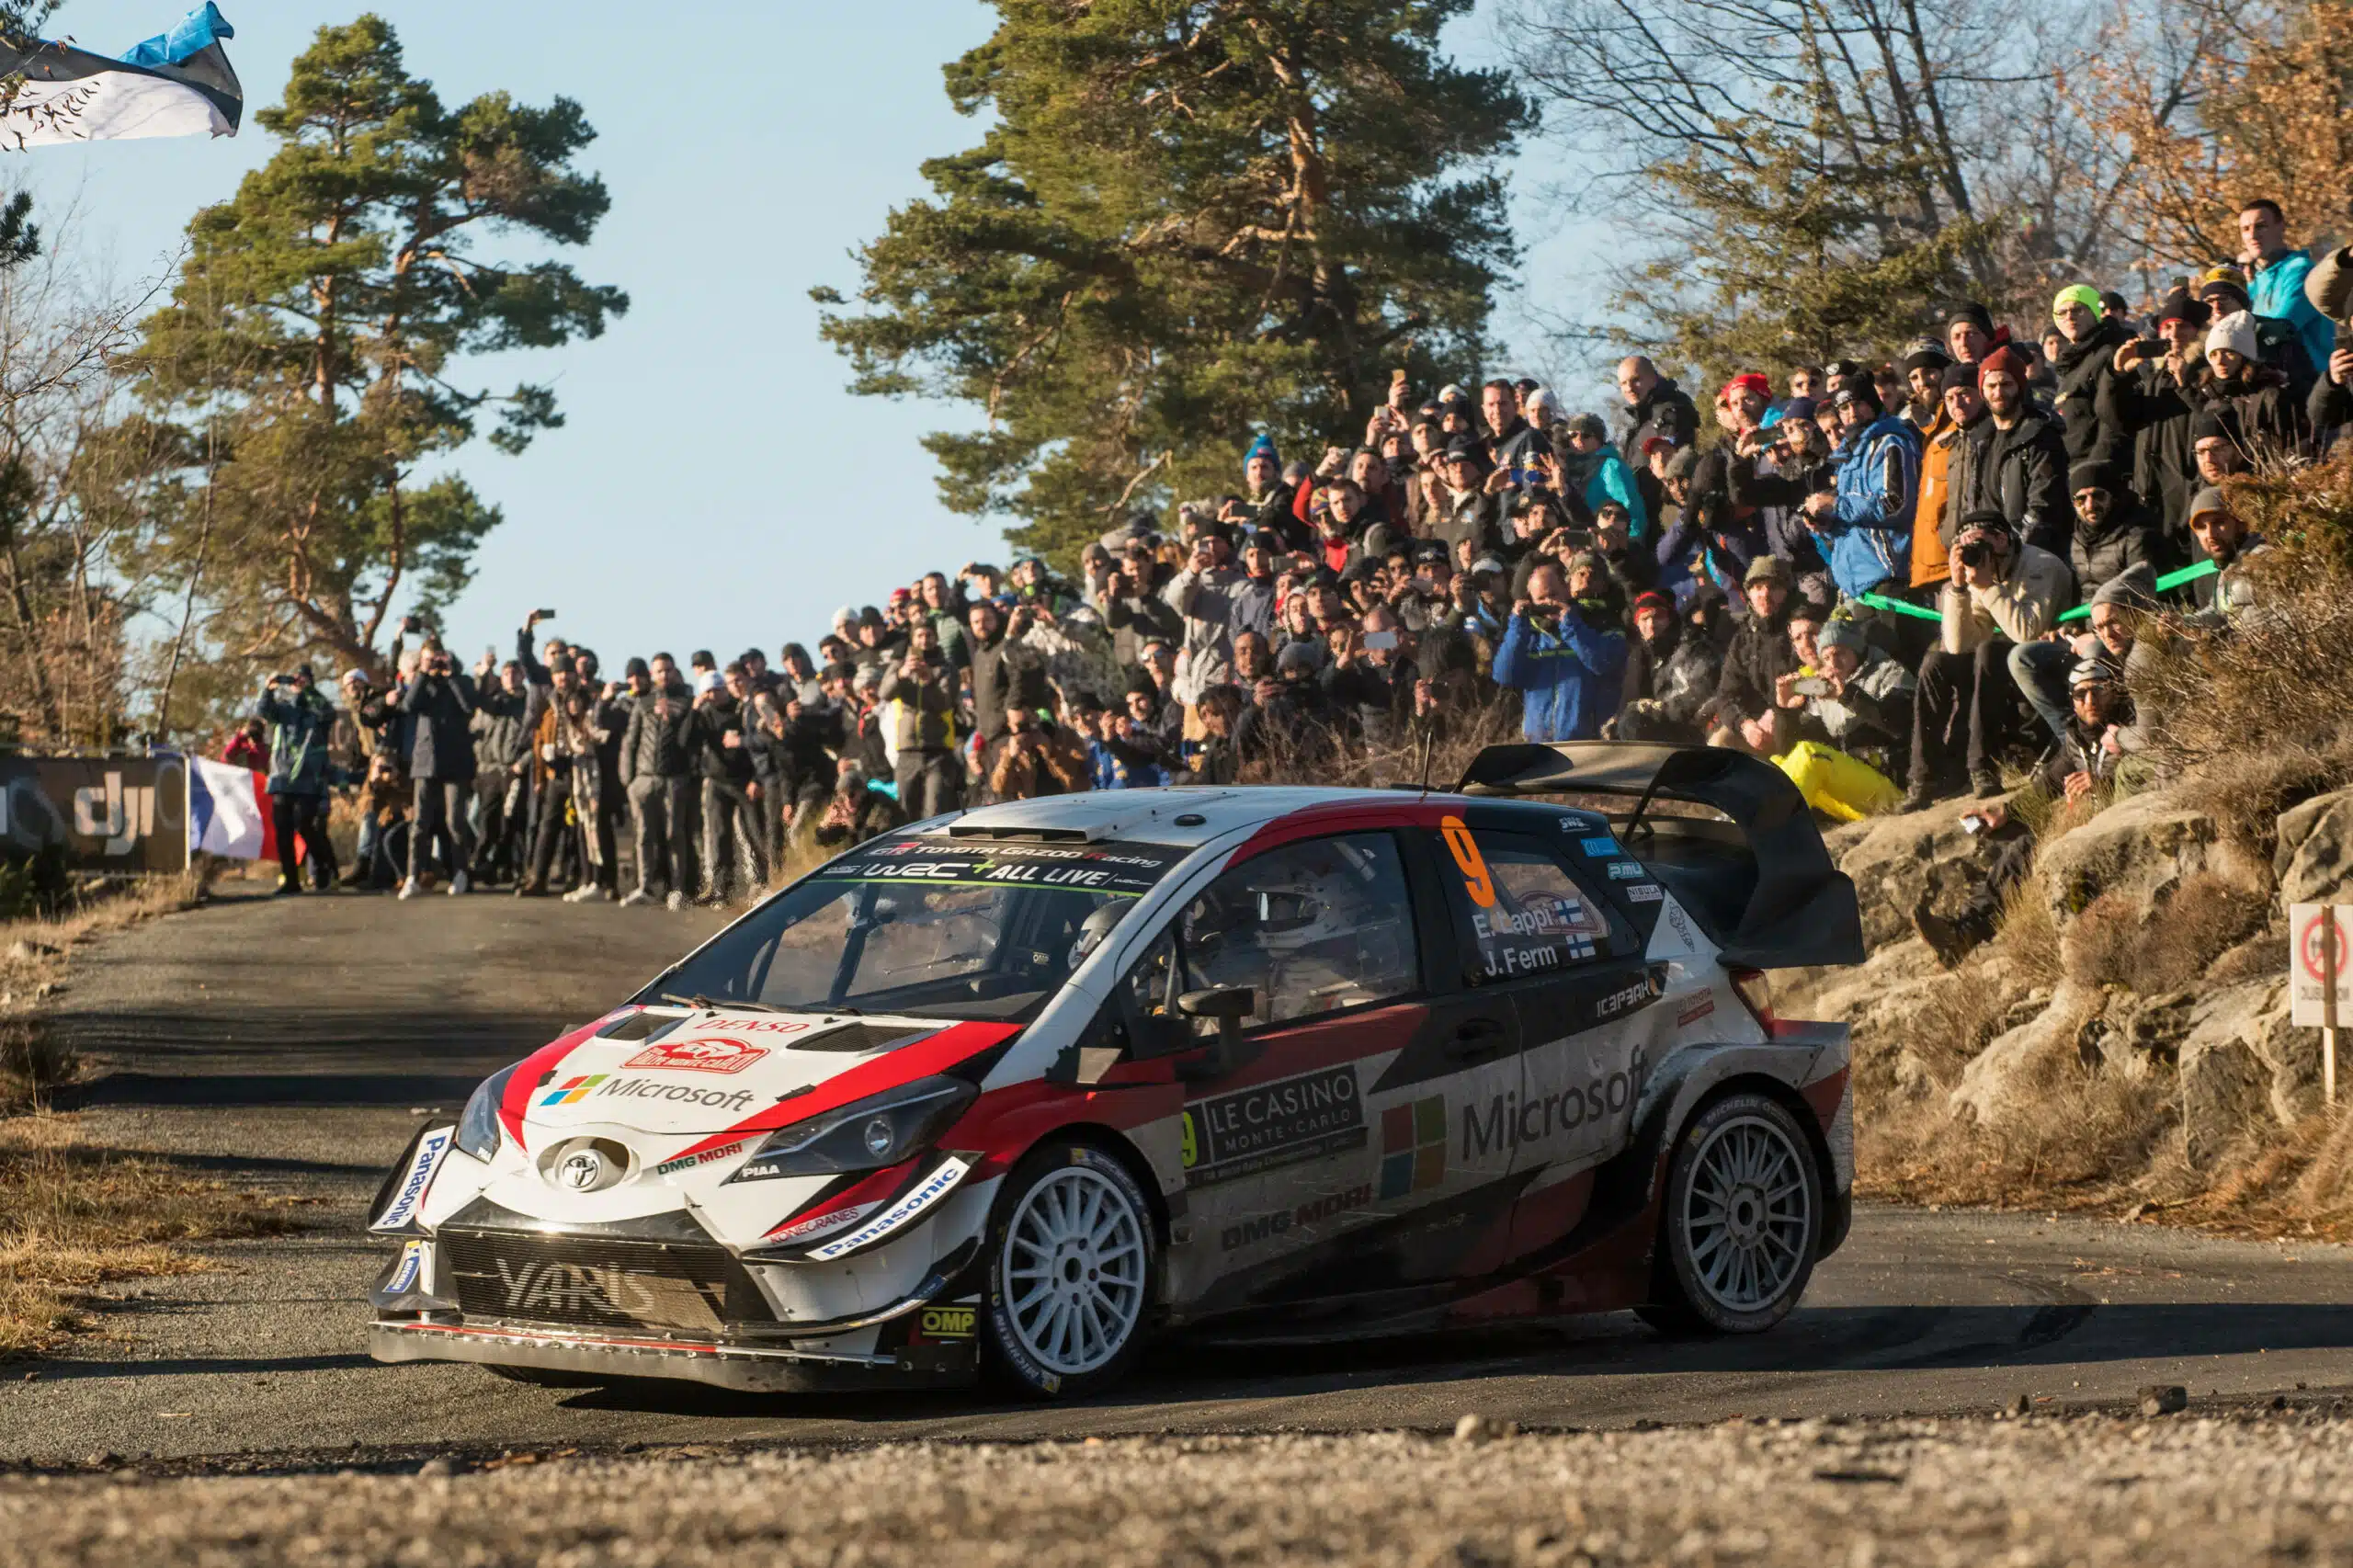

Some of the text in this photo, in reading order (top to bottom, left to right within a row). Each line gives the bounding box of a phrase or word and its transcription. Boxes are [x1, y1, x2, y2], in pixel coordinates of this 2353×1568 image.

[915, 845, 1164, 868] TOYOTA GAZOO Racing
[1440, 815, 1496, 908] 9
[985, 864, 1036, 881] ALL
[1042, 867, 1109, 886] LIVE
[1472, 914, 1496, 939] E.
[1495, 906, 1554, 937] Lappi
[1503, 945, 1559, 974] Ferm
[693, 1019, 810, 1033] DENSO
[597, 1078, 755, 1112] Microsoft
[1210, 1074, 1354, 1134] LE CASINO
[1462, 1043, 1649, 1162] Microsoft
[656, 1142, 744, 1176] DMG MORI
[742, 1164, 780, 1177] PIAA
[382, 1135, 447, 1226] Panasonic
[769, 1207, 859, 1245] KONECRANES
[823, 1167, 960, 1256] Panasonic
[922, 1311, 975, 1332] OMP
